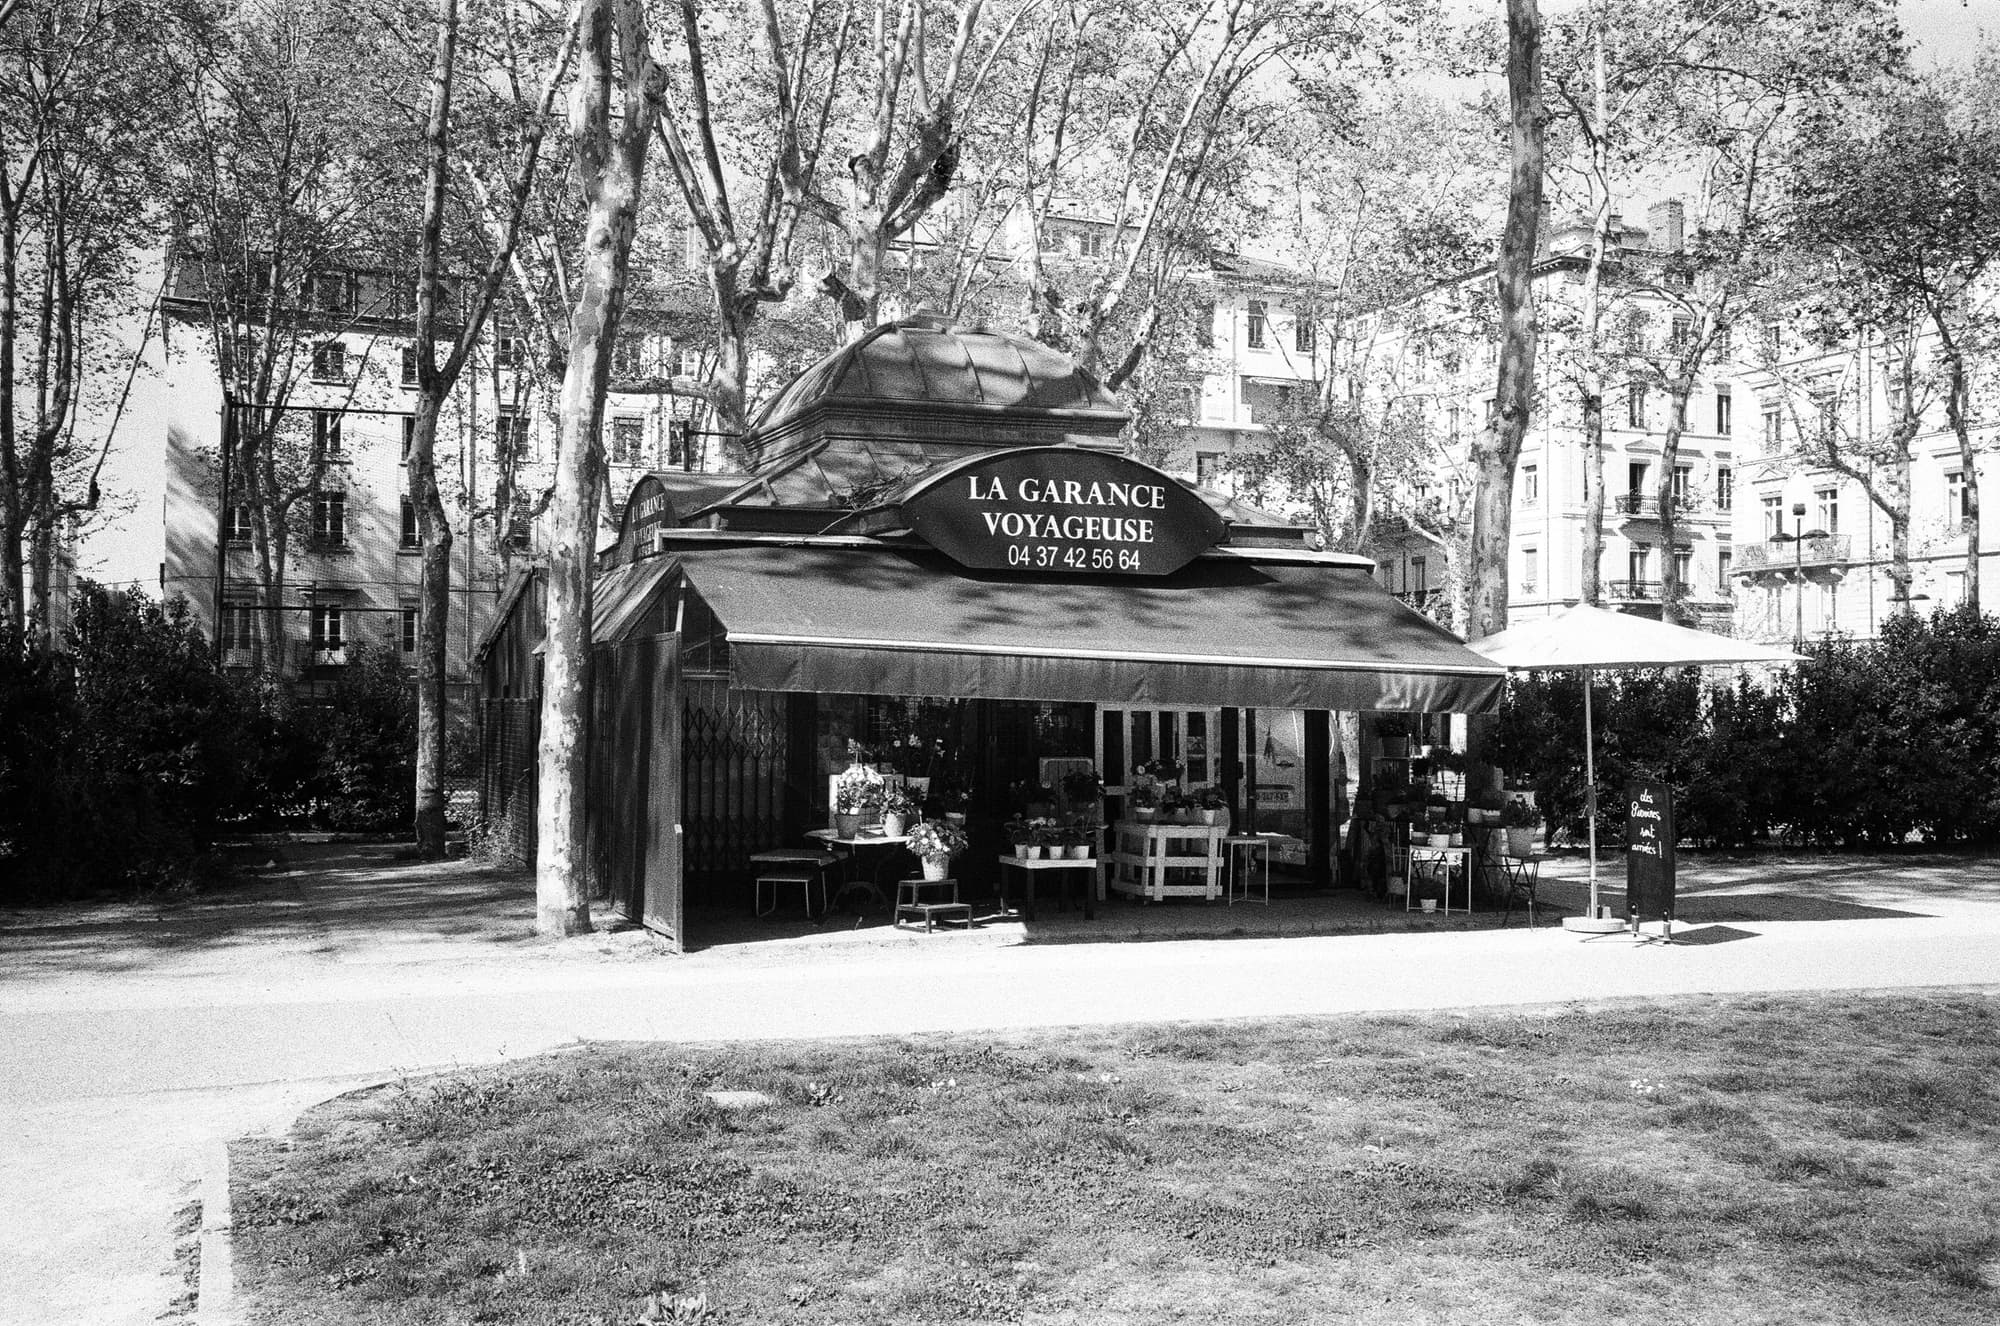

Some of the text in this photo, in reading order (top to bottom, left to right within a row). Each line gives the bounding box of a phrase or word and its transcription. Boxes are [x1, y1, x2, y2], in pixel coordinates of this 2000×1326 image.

[968, 476, 1165, 510] LA GARANCE
[981, 512, 1154, 543] VOYAGEUSE
[1008, 545, 1141, 571] 04 37 42 56 64
